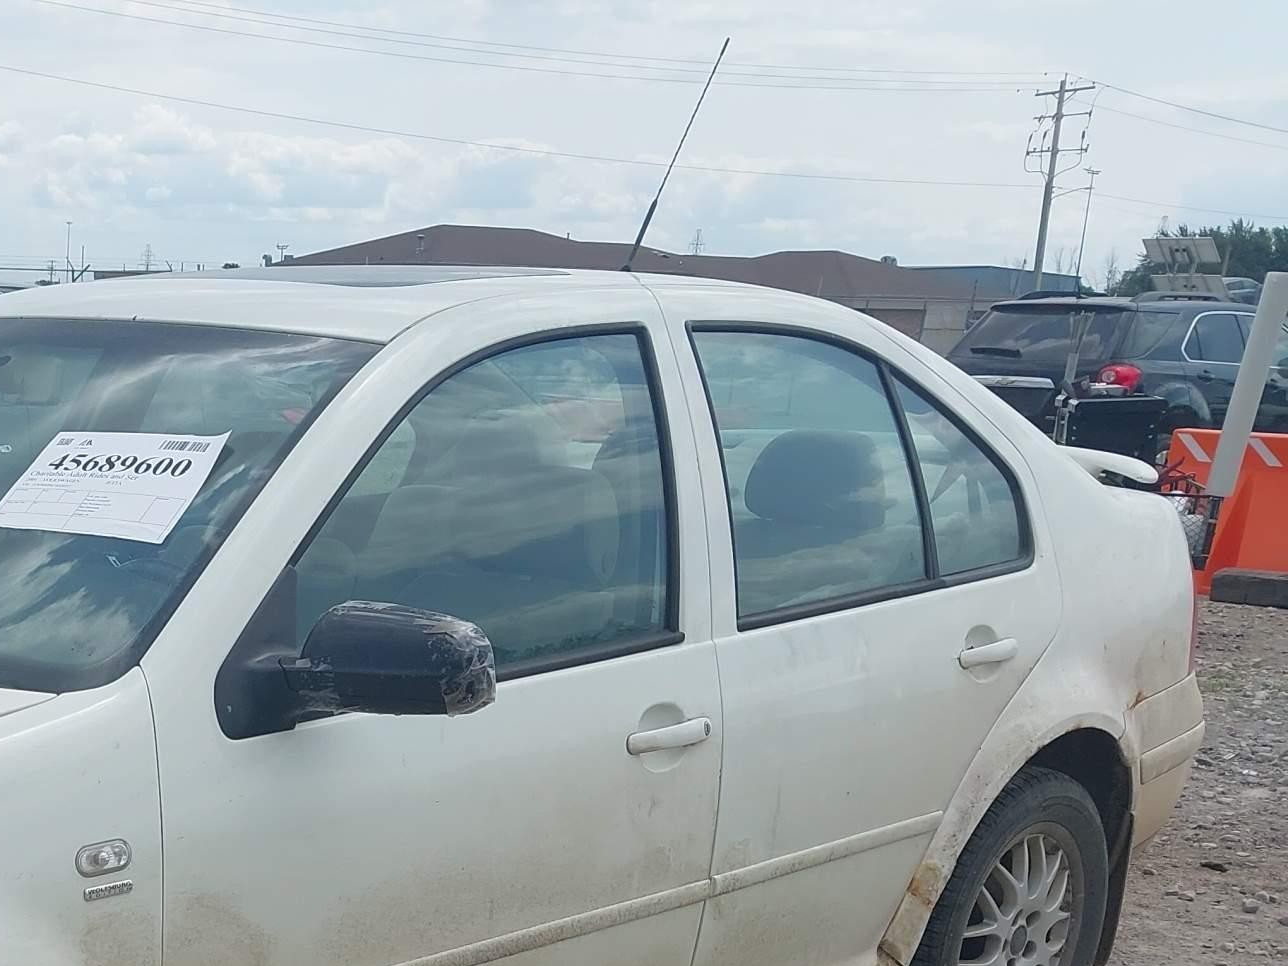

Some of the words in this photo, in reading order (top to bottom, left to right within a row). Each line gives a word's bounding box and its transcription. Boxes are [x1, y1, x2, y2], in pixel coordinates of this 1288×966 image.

[48, 453, 192, 478] 45689600
[30, 470, 66, 478] Charitable
[88, 472, 109, 480] Rides
